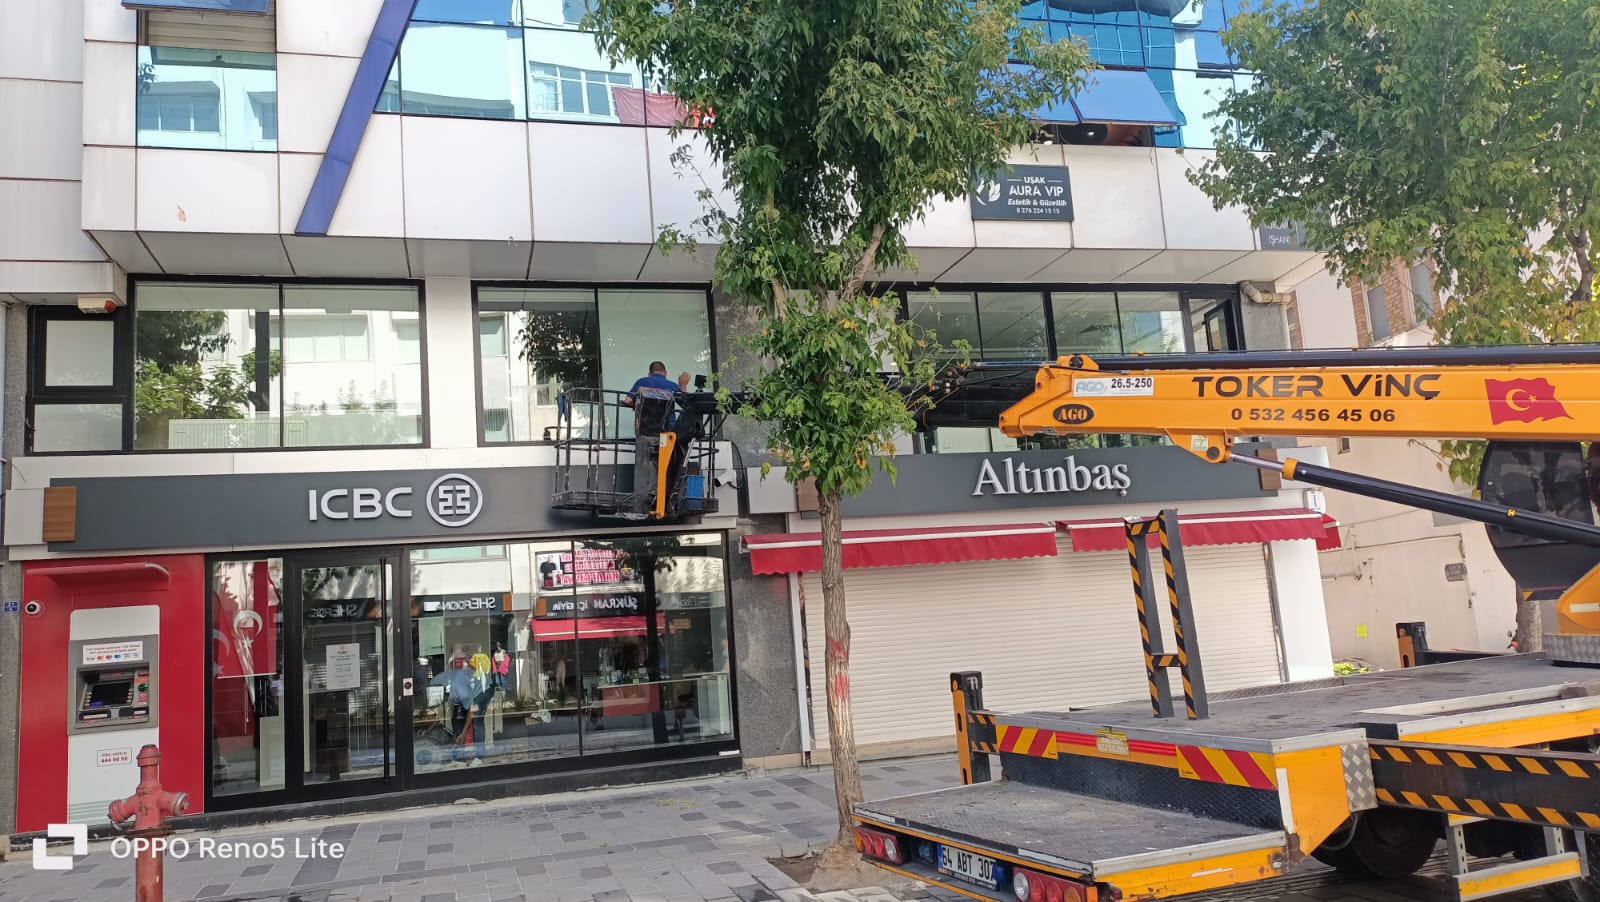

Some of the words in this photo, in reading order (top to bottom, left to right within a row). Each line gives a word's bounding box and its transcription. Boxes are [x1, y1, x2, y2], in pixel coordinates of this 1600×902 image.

[1023, 176, 1046, 184] UŞAK
[1009, 185, 1042, 196] AURA
[1044, 185, 1064, 196] VIP
[1075, 381, 1105, 393] AGO
[1111, 377, 1153, 388] 26.5-250
[1191, 375, 1324, 398] TOKER
[1058, 407, 1089, 421] AGO
[1231, 408, 1243, 420] 0
[1249, 408, 1286, 421] 532
[1291, 408, 1330, 422] 456
[1337, 408, 1362, 422] 45
[1369, 409, 1396, 422] 06
[971, 454, 1132, 497] Altınbaş
[308, 486, 413, 521] ICBC
[942, 847, 953, 868] 64
[957, 851, 972, 875] ABT
